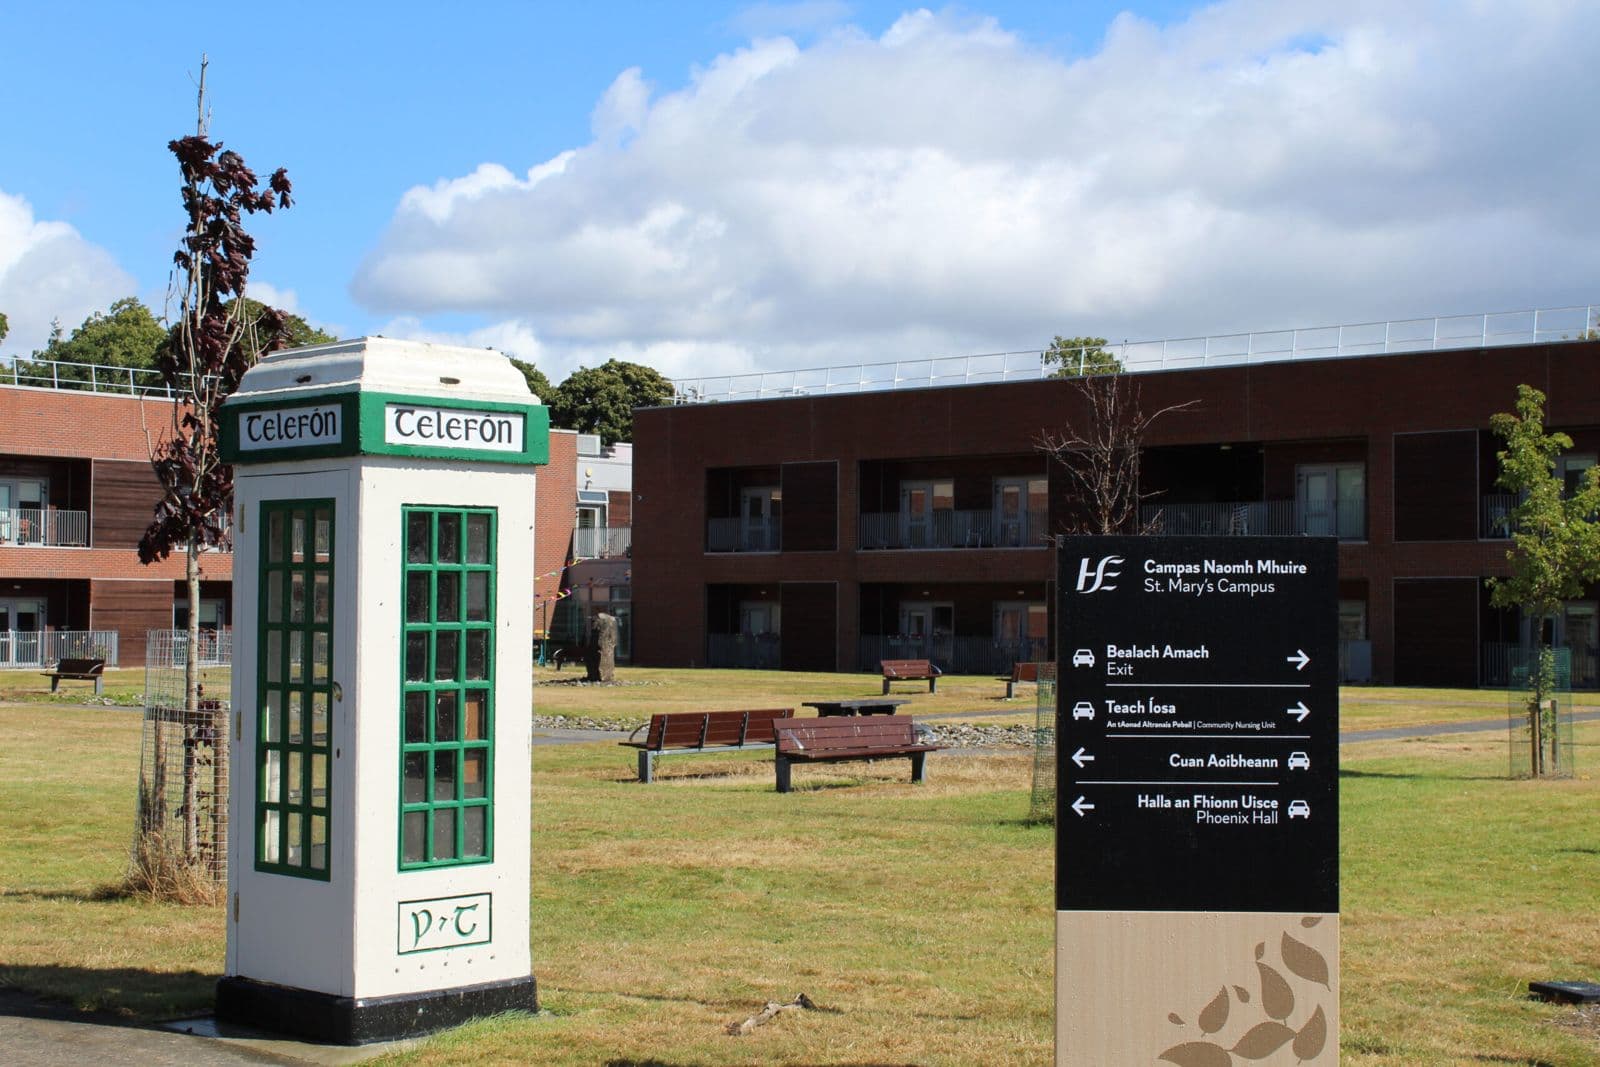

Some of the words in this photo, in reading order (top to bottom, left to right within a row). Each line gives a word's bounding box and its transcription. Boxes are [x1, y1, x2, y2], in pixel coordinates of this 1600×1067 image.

[1143, 559, 1201, 578] Campas
[1203, 559, 1254, 574] Naomh
[1257, 559, 1307, 574] Mhuire
[1144, 577, 1165, 593] St.
[1168, 577, 1214, 597] Mary's
[1217, 578, 1275, 597] Campus
[1107, 644, 1160, 659] Bealach
[1162, 644, 1209, 659] Amach
[1107, 661, 1134, 676] Exit
[1105, 699, 1145, 714] Teach
[1149, 696, 1176, 714] Íosa
[1196, 720, 1235, 731] Community
[1235, 720, 1261, 731] Nursing
[1261, 721, 1276, 730] Unit
[1169, 753, 1204, 768] Cuan
[1207, 753, 1279, 768] Aoibheann
[1137, 794, 1172, 809] Halla
[1174, 798, 1190, 809] an
[1193, 794, 1239, 809] Fhionn
[1241, 794, 1279, 809] Uisce
[1196, 810, 1249, 825] Phoenix
[1252, 810, 1278, 825] Hall
